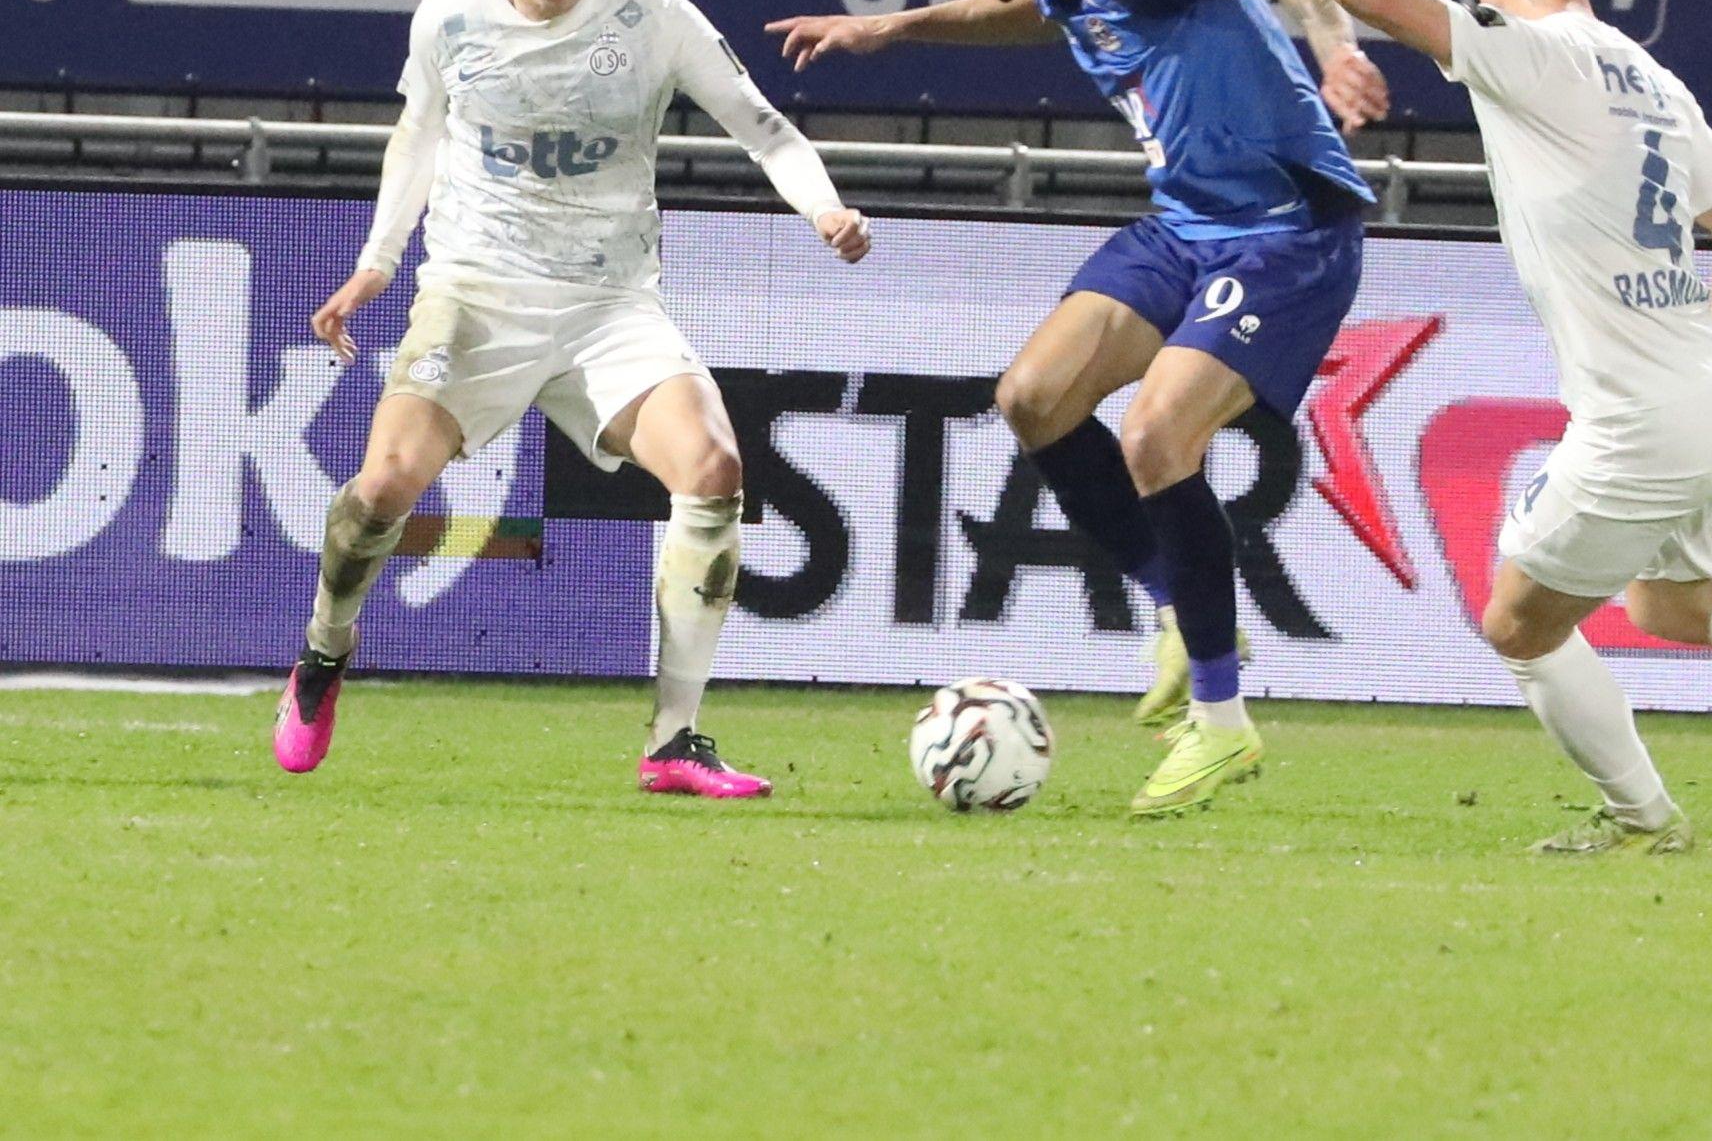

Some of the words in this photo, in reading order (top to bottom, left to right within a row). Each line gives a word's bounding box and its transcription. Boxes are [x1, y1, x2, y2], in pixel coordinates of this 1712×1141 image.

[1632, 129, 1684, 266] 4
[1194, 276, 1244, 323] 9
[1523, 471, 1549, 517] 4
